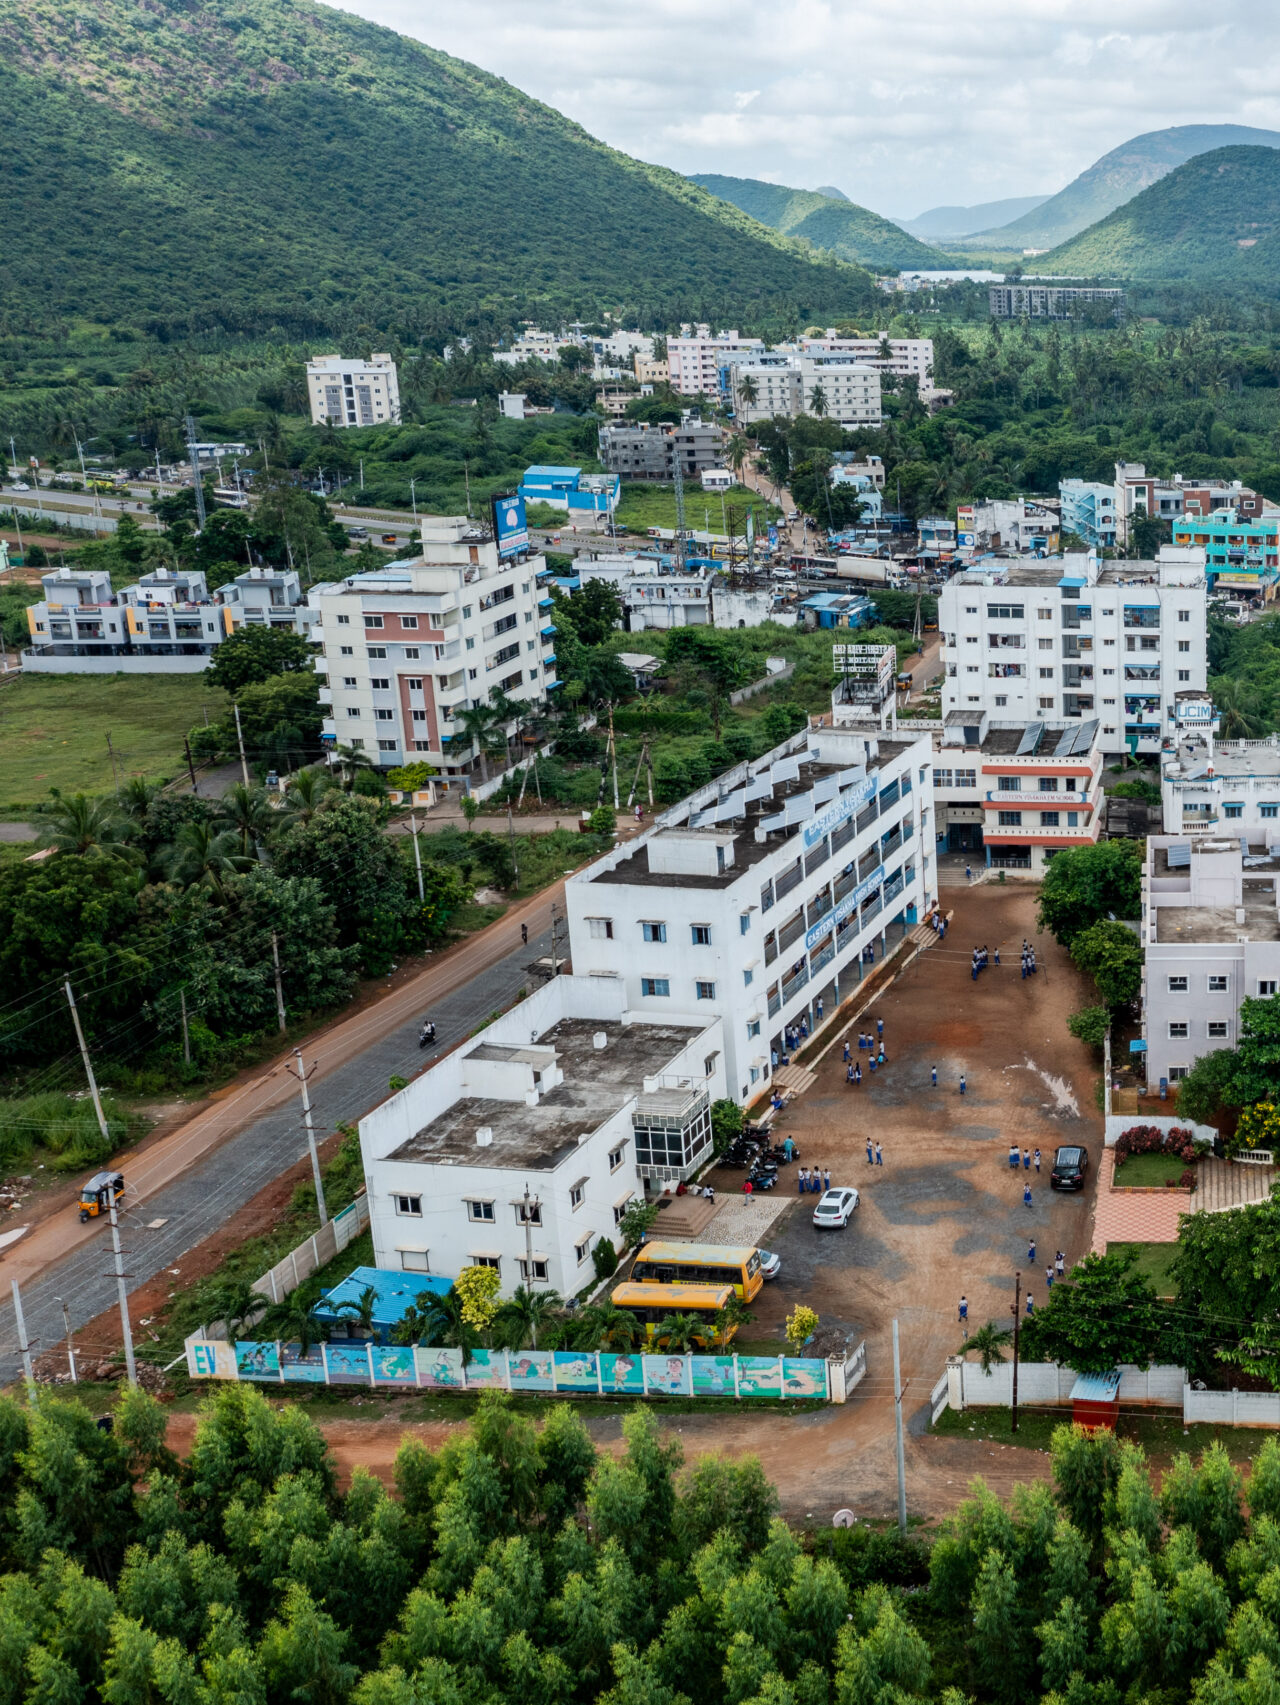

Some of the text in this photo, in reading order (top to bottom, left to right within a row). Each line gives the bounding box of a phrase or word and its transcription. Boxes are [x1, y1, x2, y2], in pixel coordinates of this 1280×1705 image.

[1177, 704, 1210, 718] UCIM
[808, 778, 873, 836] EASTERN VISAKHA
[807, 871, 884, 946] EASTERN VISAKHA HIGH SCHOOL
